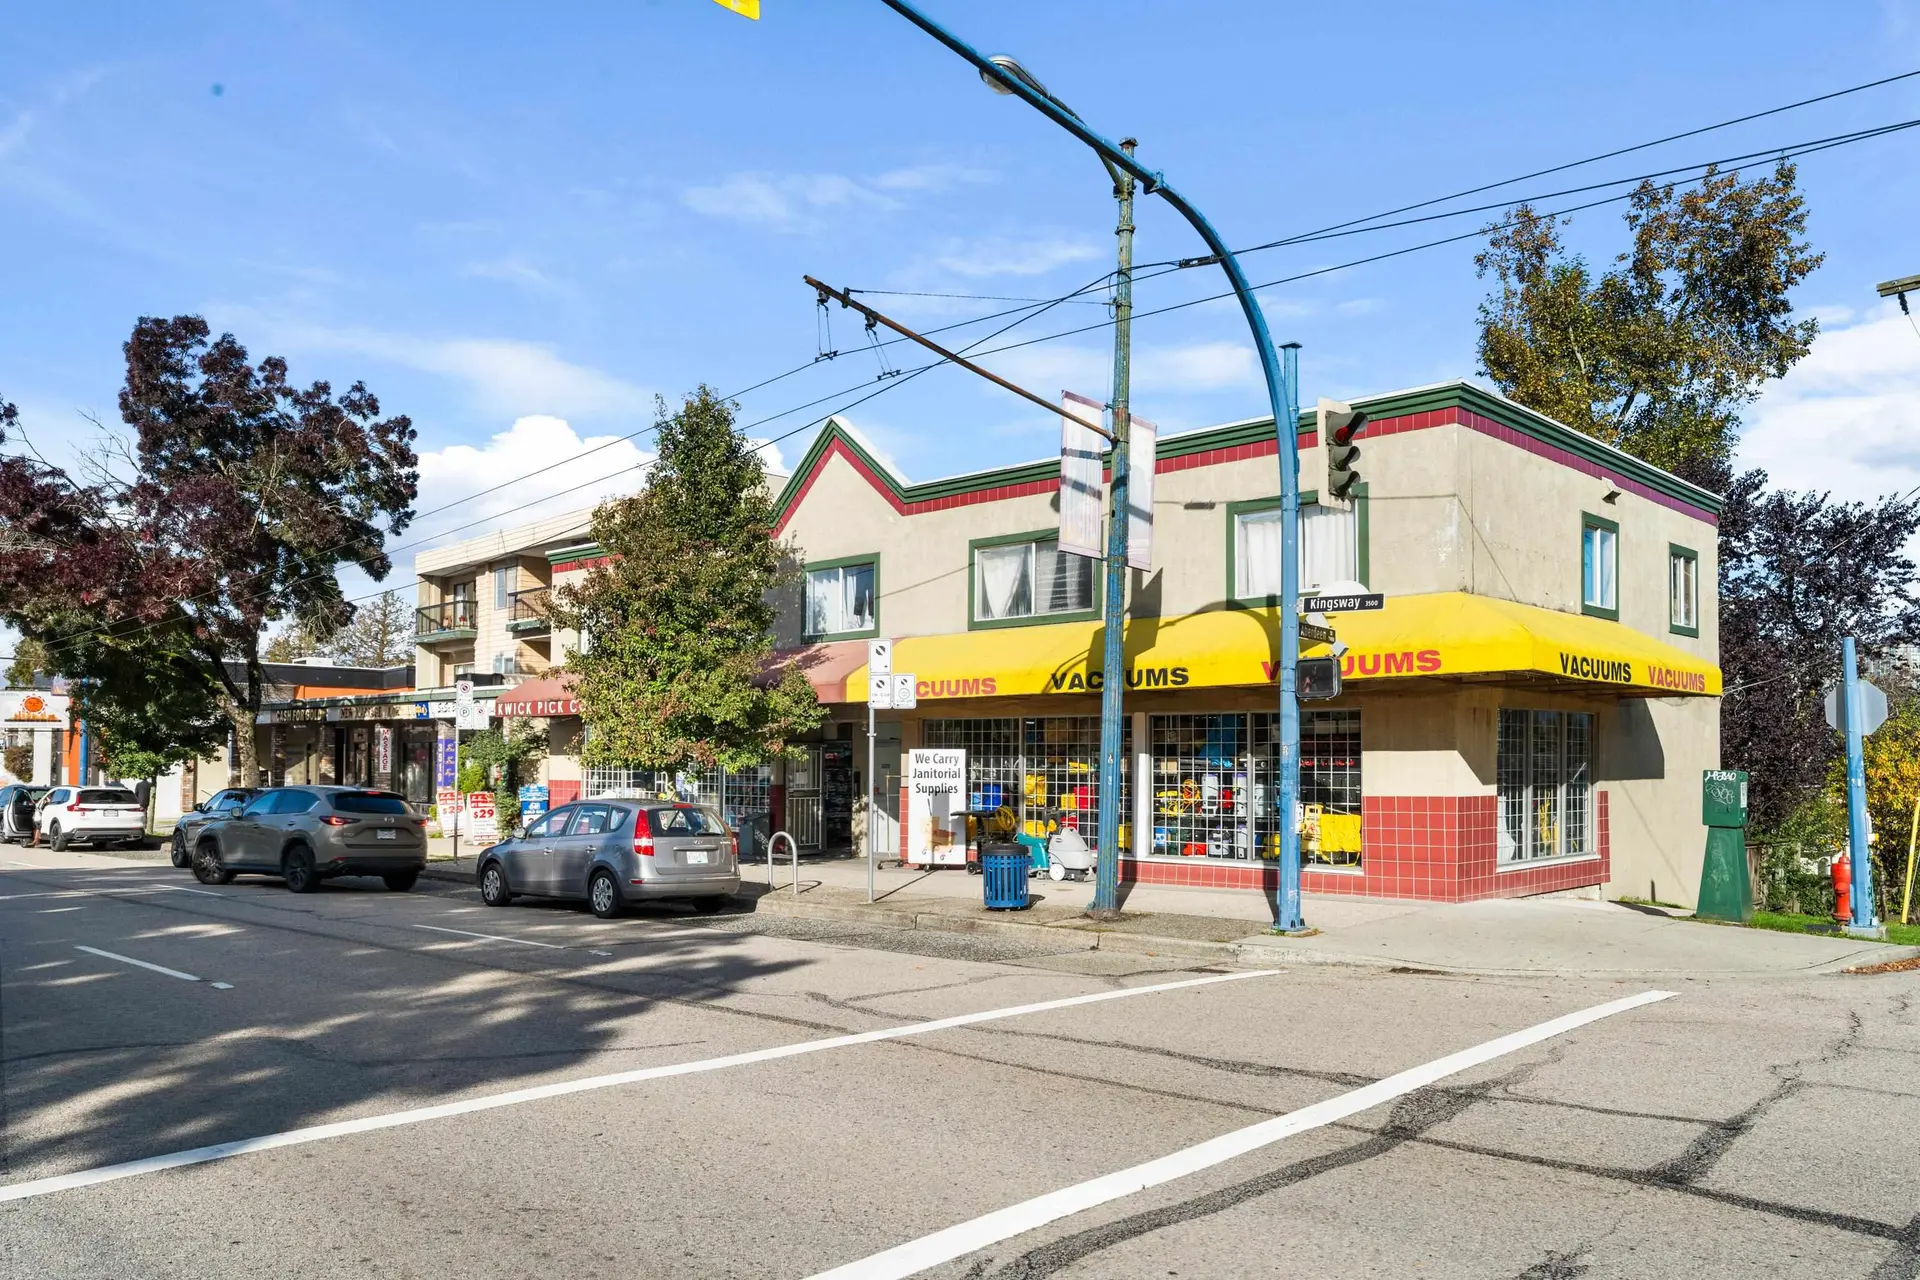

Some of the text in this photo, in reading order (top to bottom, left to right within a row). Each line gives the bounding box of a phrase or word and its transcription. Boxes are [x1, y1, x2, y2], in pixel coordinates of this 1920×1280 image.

[1310, 598, 1361, 611] Kingsway
[1261, 650, 1442, 681] VUUMS
[1559, 652, 1632, 683] VACUUMS
[1051, 667, 1190, 691] VACUMS
[1648, 665, 1705, 692] VACUUMS
[915, 677, 997, 698] CUUMS
[305, 708, 322, 721] GOLD
[497, 702, 532, 716] KWICK
[537, 700, 564, 714] PICK
[382, 729, 390, 770] MASSAGE
[915, 753, 960, 767] We Carry
[912, 768, 961, 779] Janitorial
[915, 782, 959, 796] Supplies
[473, 809, 495, 819] $29
